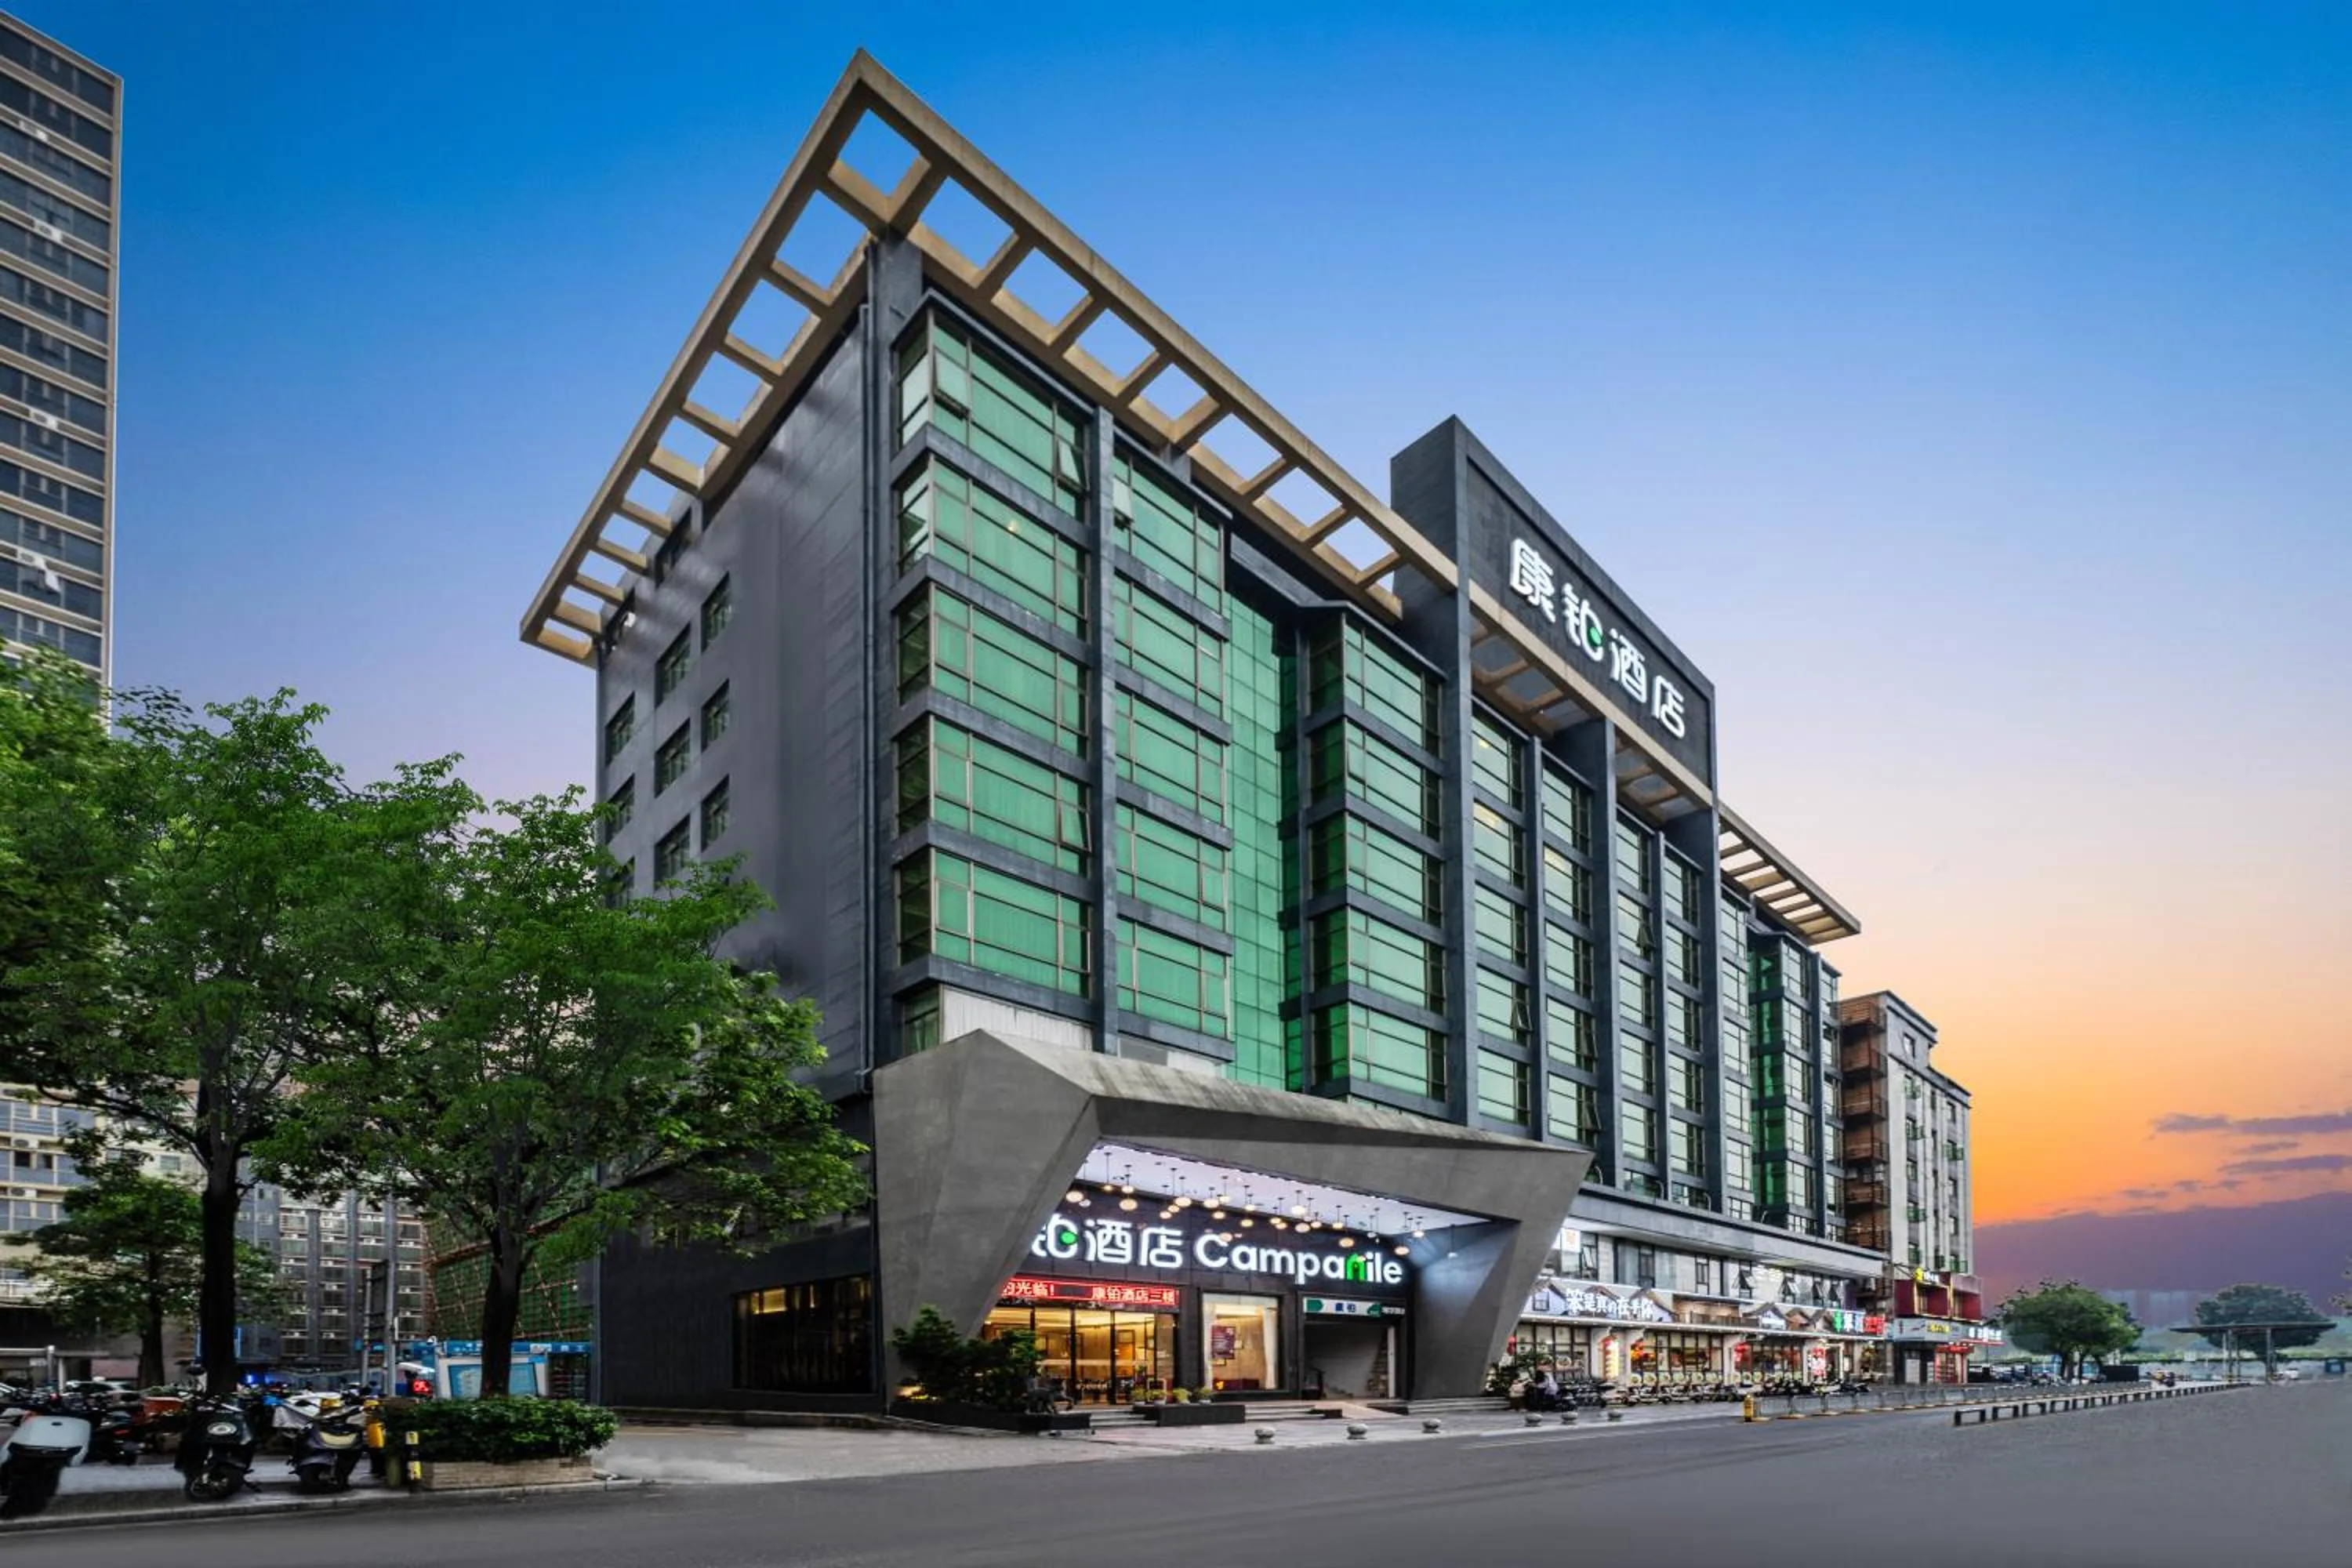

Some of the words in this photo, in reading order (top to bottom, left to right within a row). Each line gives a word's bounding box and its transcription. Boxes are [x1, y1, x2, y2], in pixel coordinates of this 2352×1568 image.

[1510, 538, 1685, 739] 康铂酒店
[1194, 1232, 1403, 1285] Campanile
